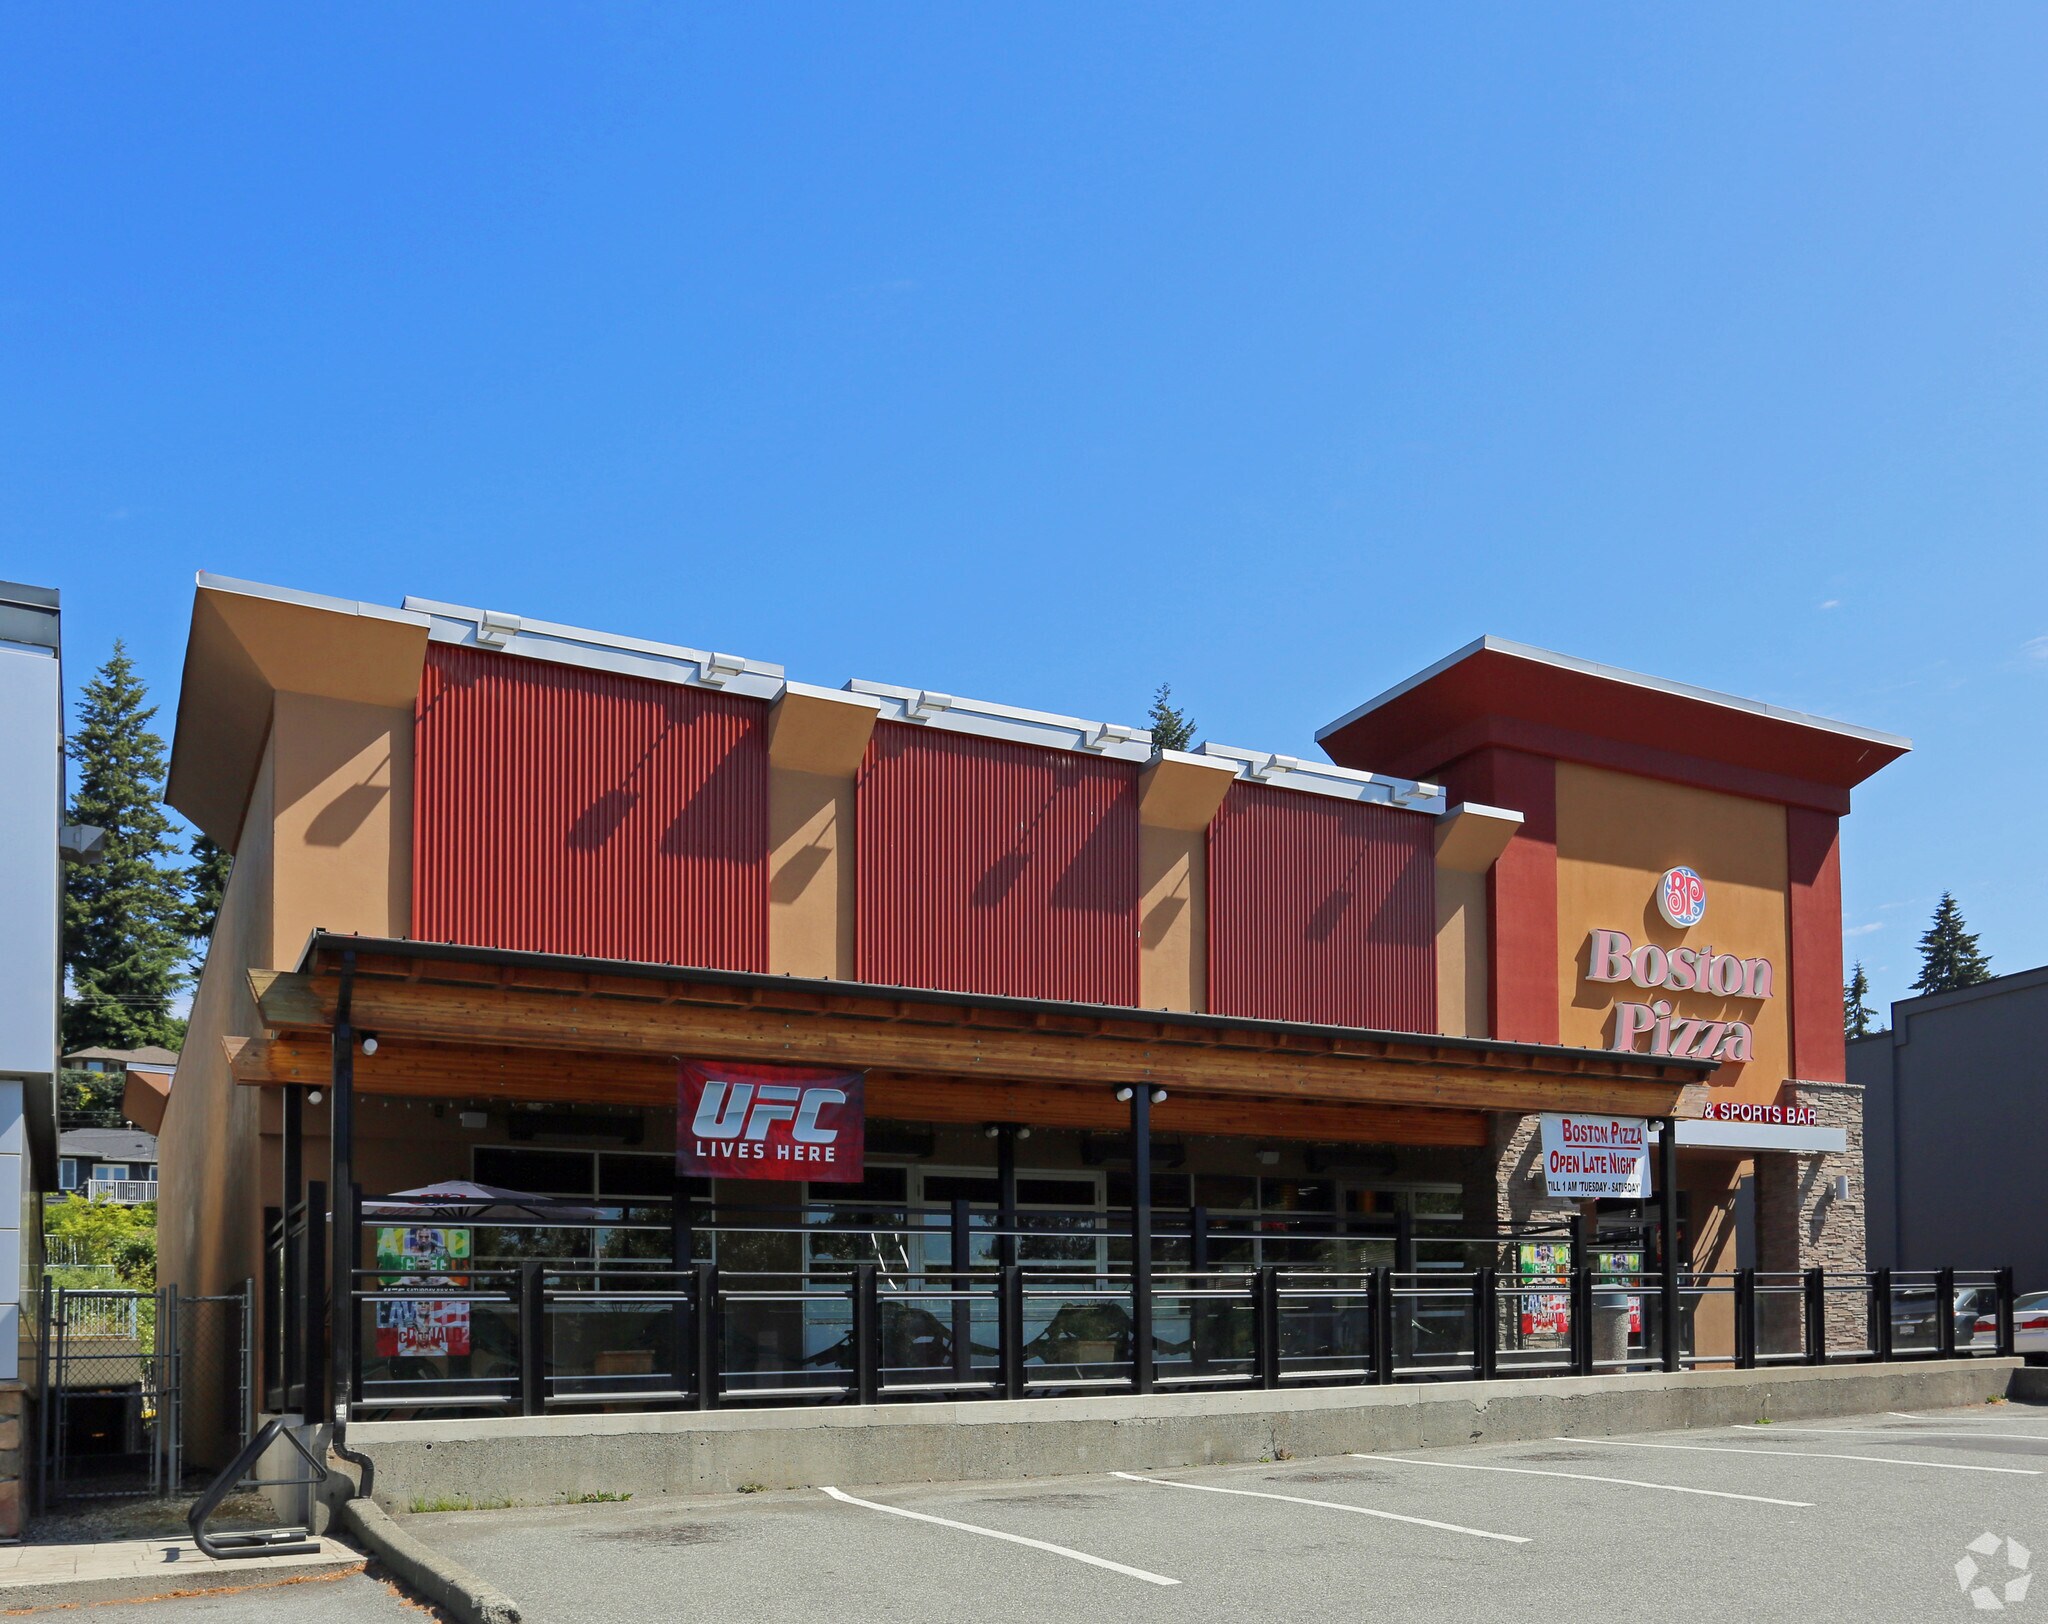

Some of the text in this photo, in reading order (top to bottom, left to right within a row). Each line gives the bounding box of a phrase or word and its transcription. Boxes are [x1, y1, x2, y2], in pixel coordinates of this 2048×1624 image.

[1667, 871, 1704, 916] BP
[1586, 928, 1773, 999] Boston
[1613, 1000, 1754, 1062] Pizza
[692, 1081, 847, 1144] UFC
[1704, 1102, 1817, 1125] & SPORTS BAR
[1562, 1119, 1643, 1144] BOSTON PIZZA
[696, 1140, 835, 1163] LIVES HERE
[1550, 1150, 1637, 1174] OPEN LATE NIGHT
[1548, 1181, 1561, 1191] TILL
[1568, 1181, 1577, 1191] AM
